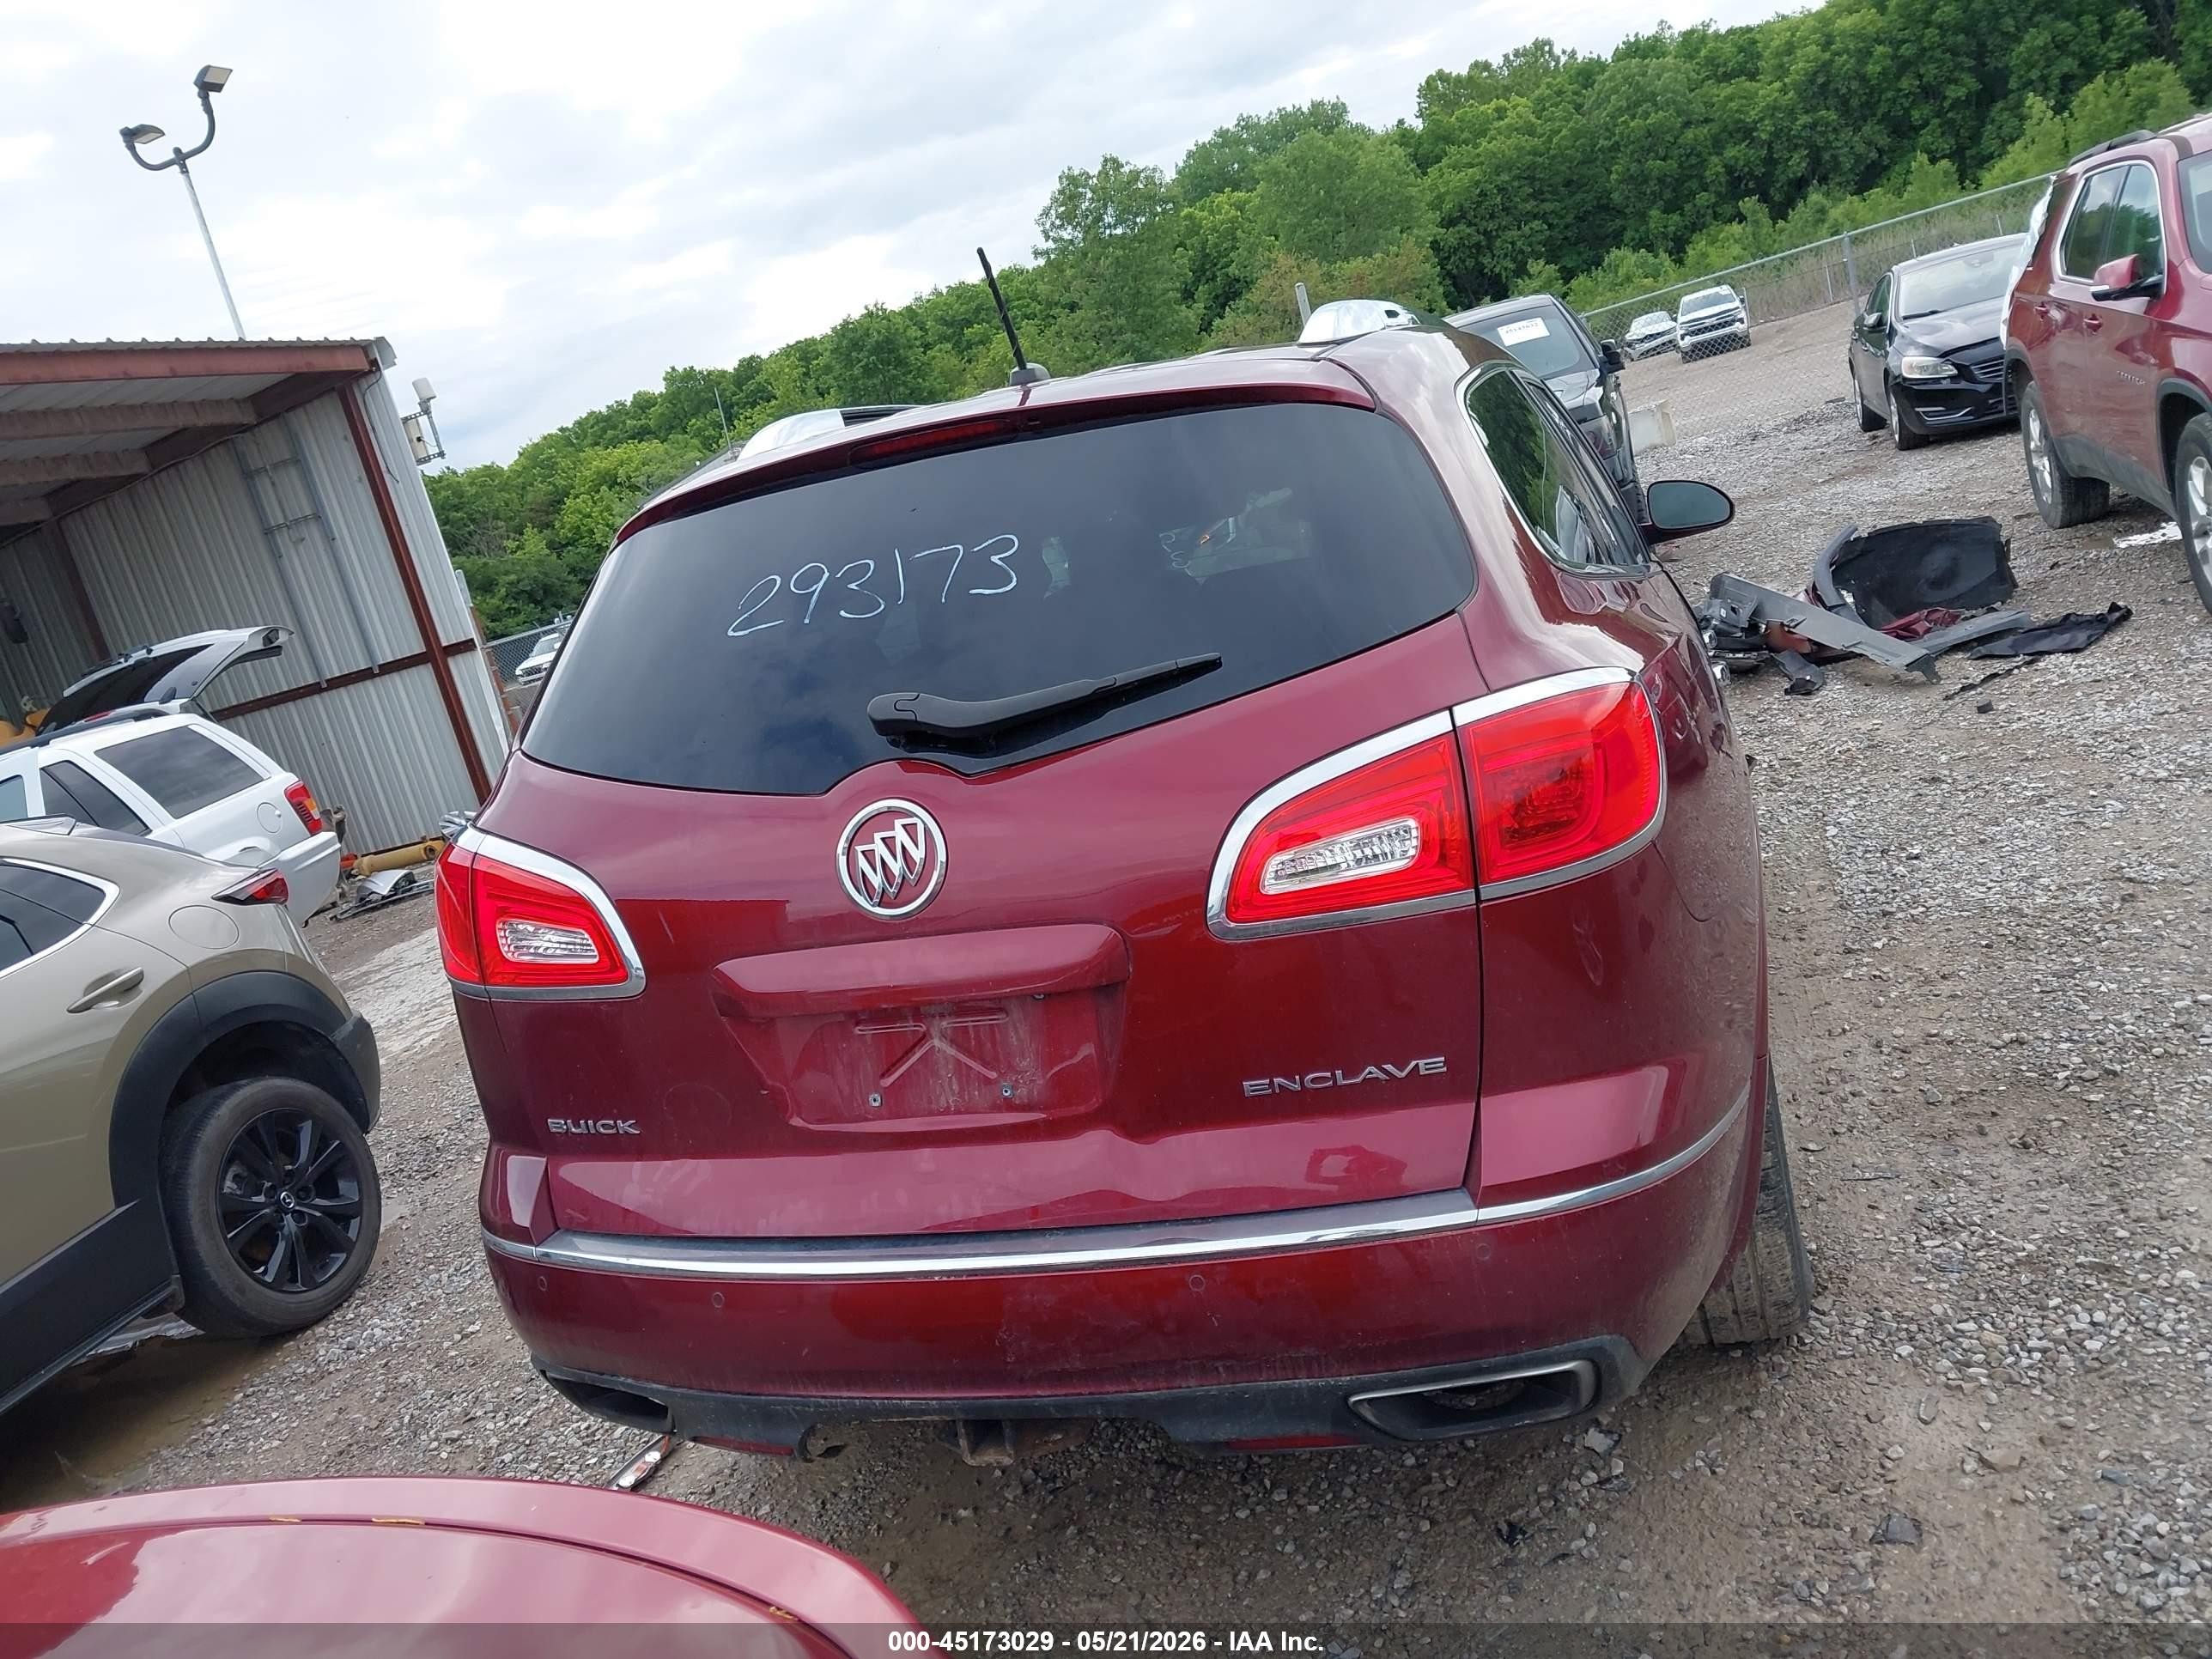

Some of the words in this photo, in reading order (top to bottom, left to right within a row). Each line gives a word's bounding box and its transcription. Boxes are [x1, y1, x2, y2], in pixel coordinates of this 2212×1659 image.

[727, 534, 1018, 636] 293173
[1243, 1056, 1448, 1097] ENCLAVE
[547, 1119, 641, 1134] BUICK
